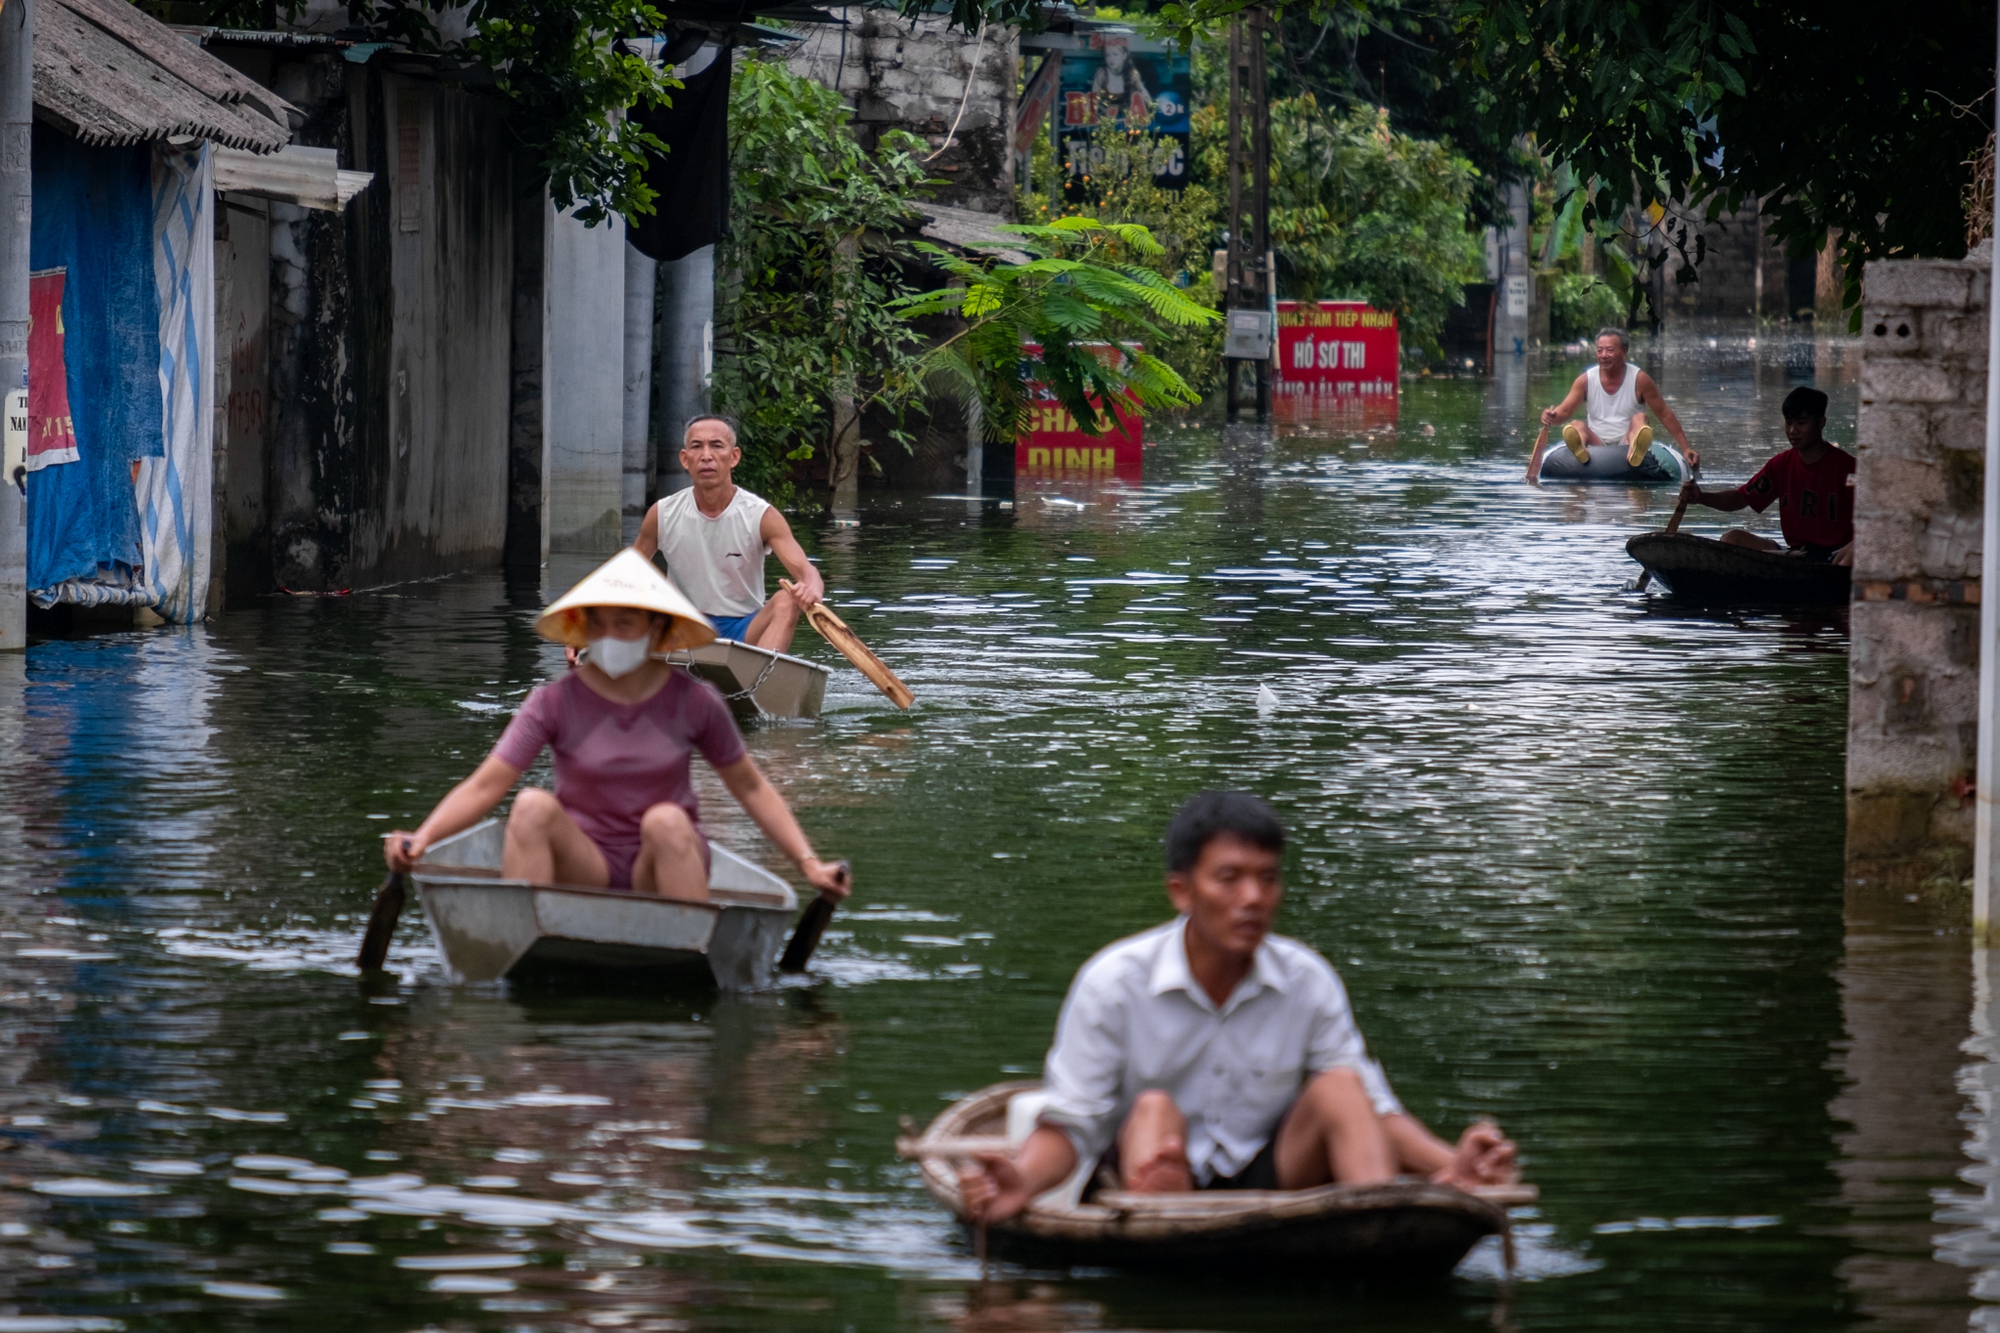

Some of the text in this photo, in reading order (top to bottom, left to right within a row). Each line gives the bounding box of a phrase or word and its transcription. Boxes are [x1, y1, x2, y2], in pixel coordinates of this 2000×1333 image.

[1294, 333, 1366, 369] HỒ SƠ THI
[55, 416, 74, 436] 15
